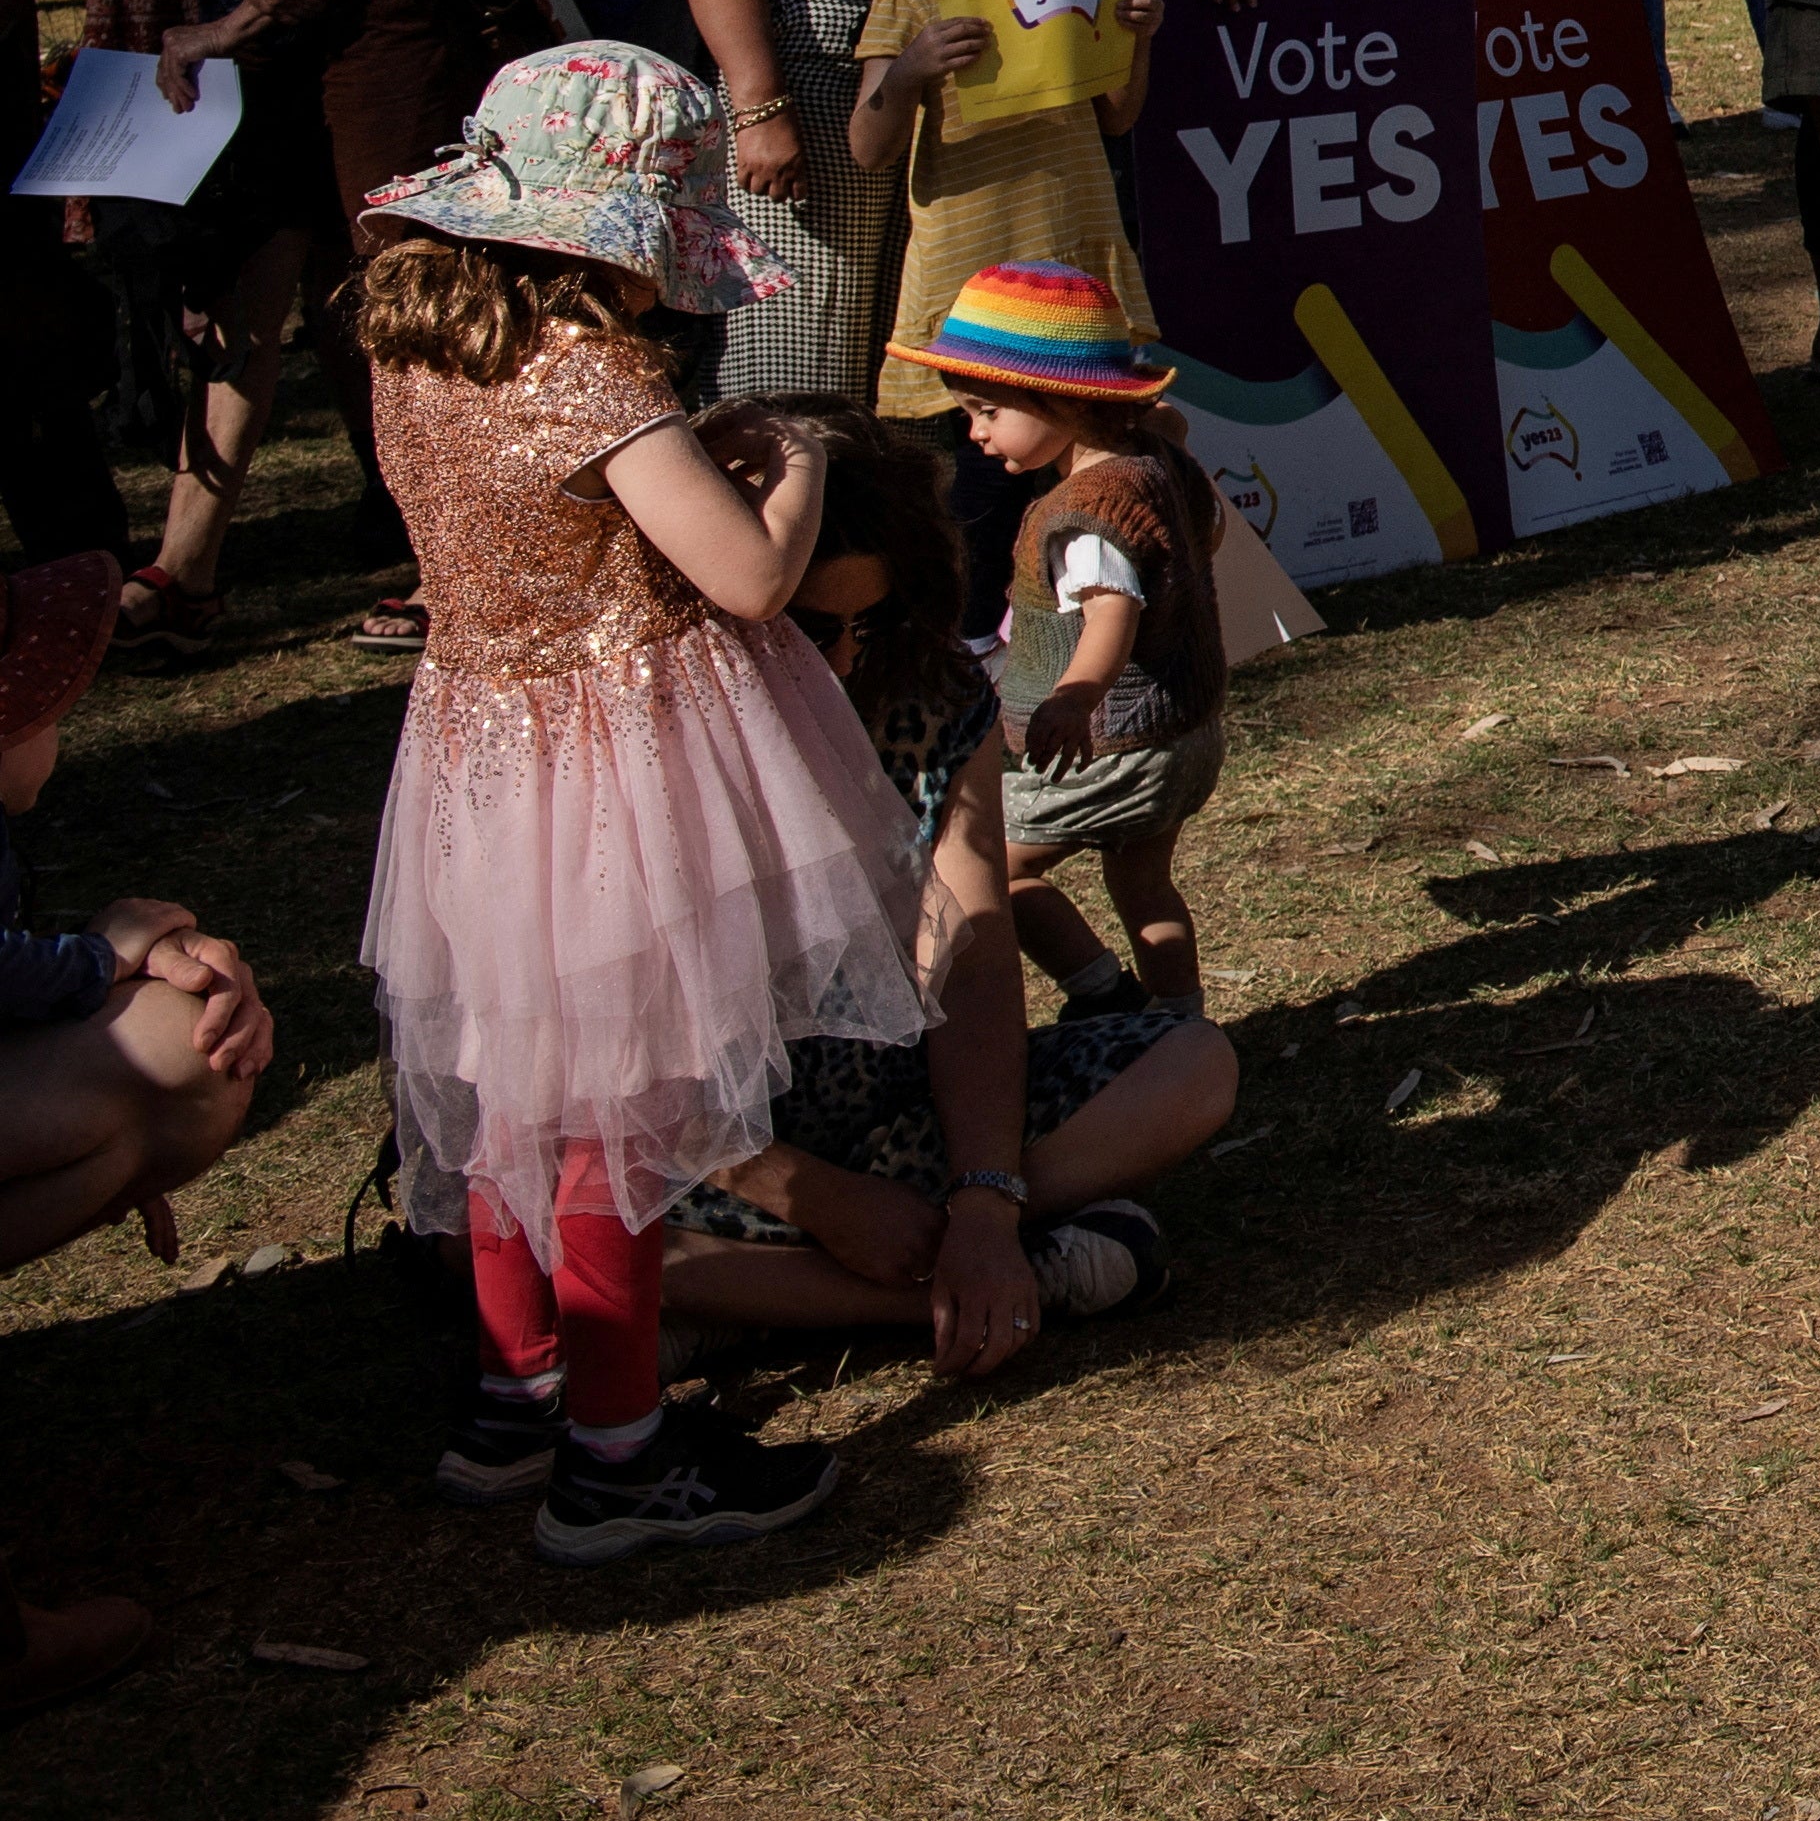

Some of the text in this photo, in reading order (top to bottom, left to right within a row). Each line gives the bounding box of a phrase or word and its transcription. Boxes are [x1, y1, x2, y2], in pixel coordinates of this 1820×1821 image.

[1216, 20, 1399, 100] Vote
[1475, 10, 1591, 78] ote
[1176, 102, 1443, 246] YES
